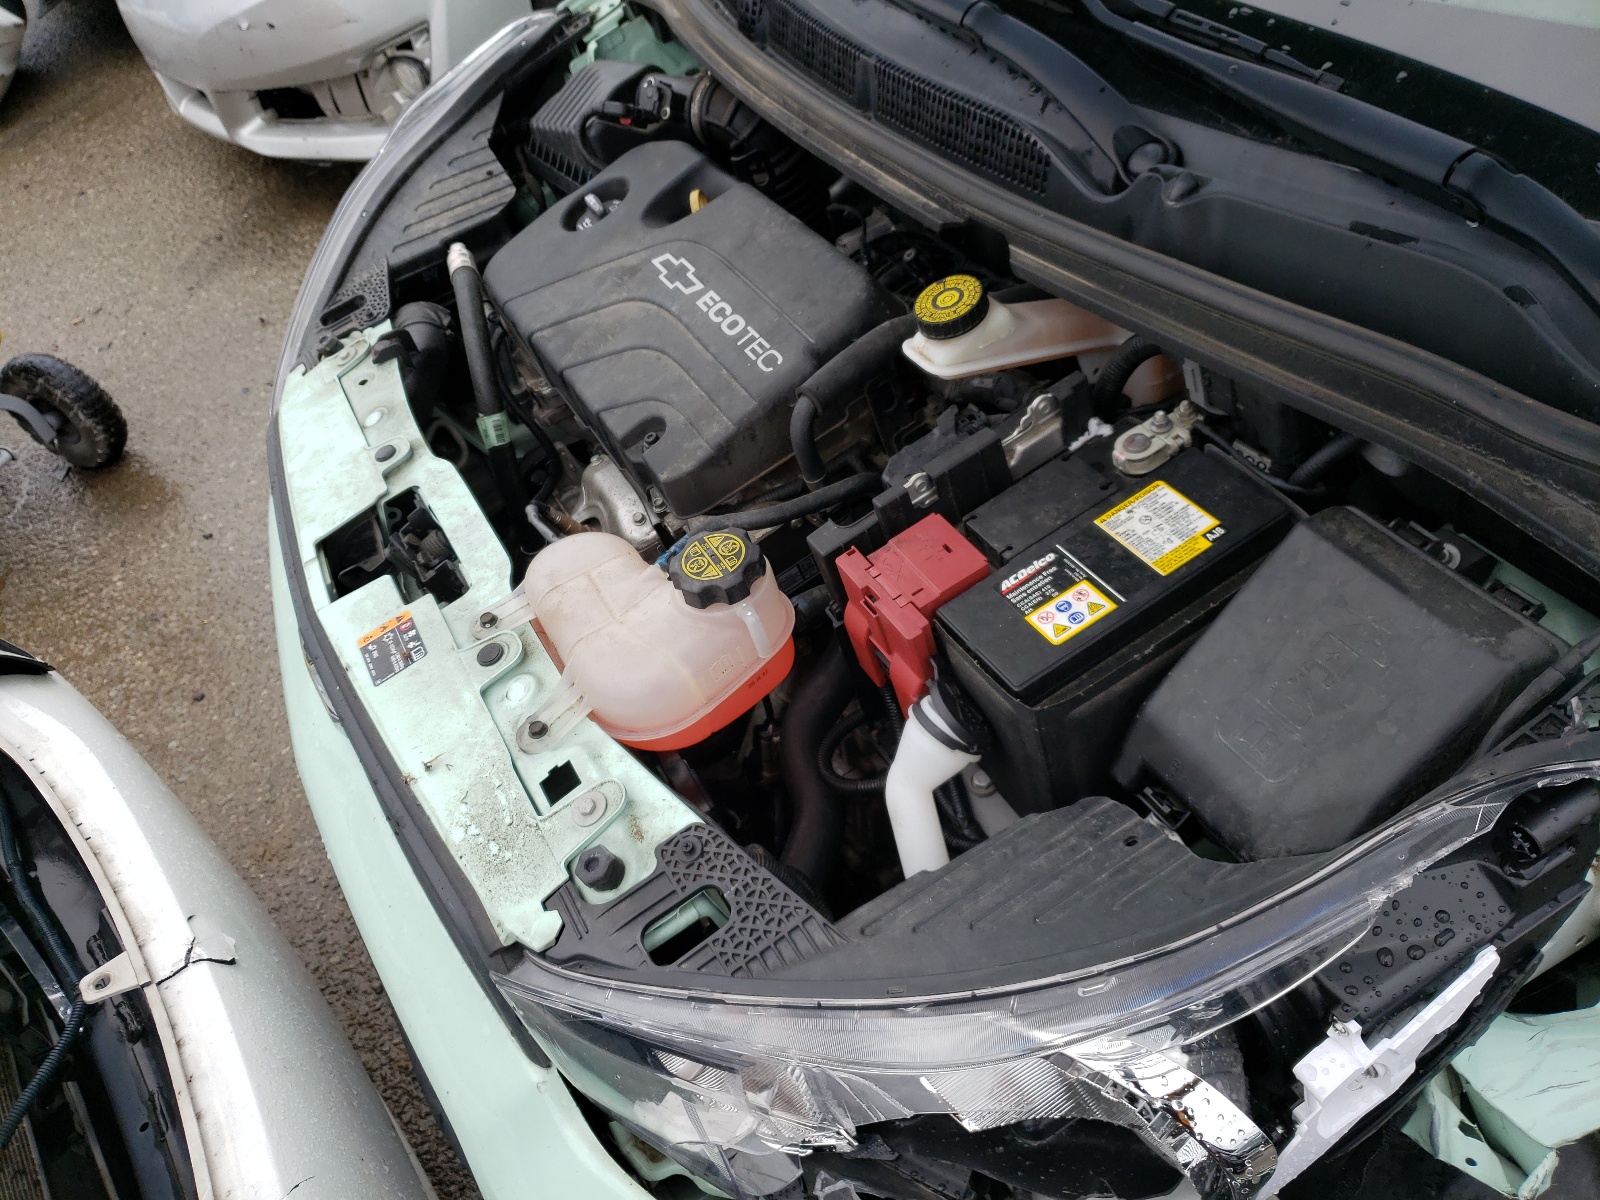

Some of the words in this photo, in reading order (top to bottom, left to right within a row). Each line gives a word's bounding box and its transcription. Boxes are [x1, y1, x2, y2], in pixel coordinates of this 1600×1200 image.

[695, 290, 783, 372] ECOTEC
[1001, 553, 1055, 592] ACDelco
[1006, 575, 1044, 600] Maintenance
[1042, 566, 1057, 577] Free
[1011, 592, 1027, 604] Sans
